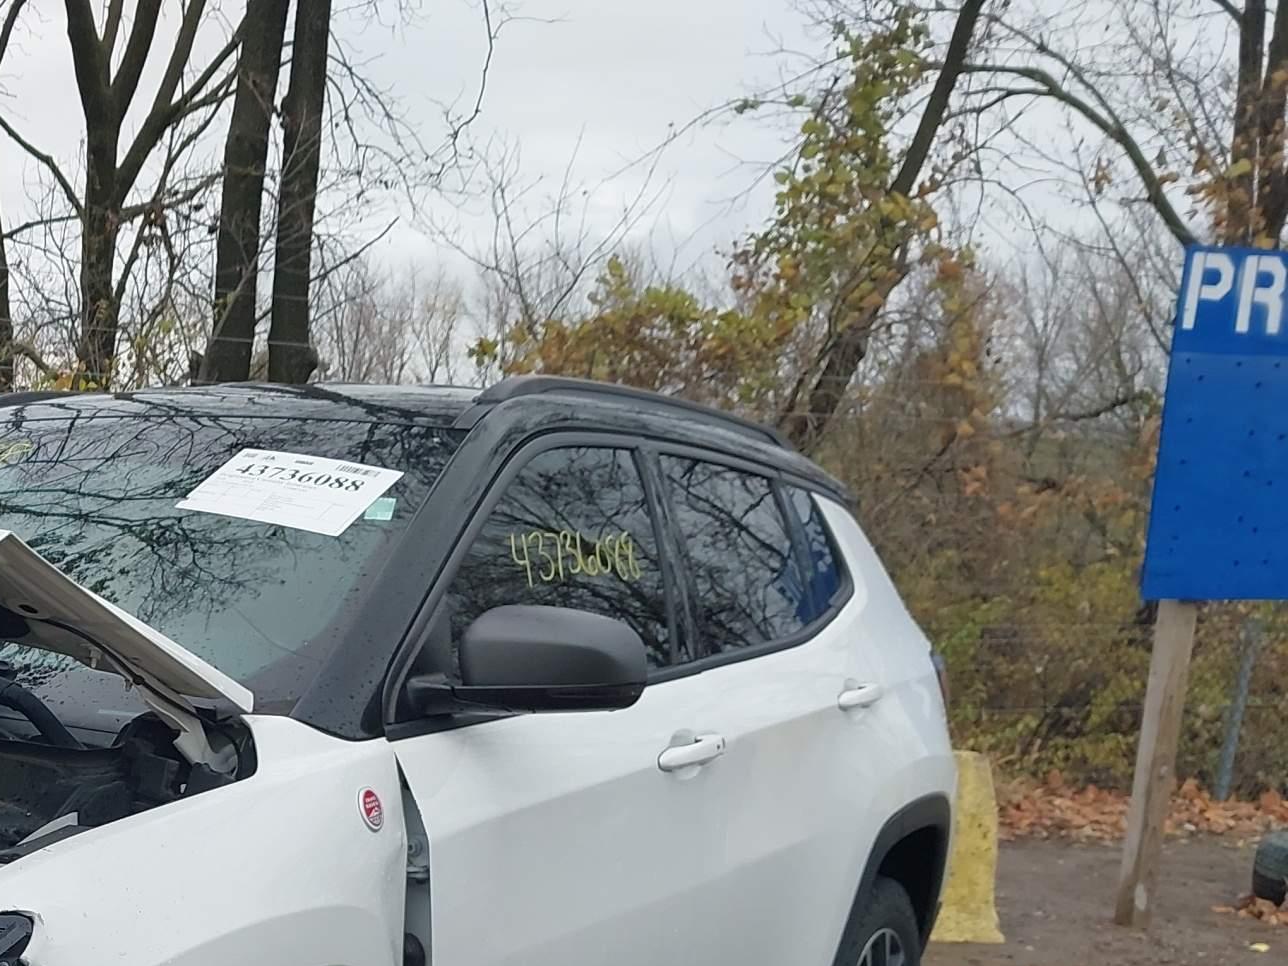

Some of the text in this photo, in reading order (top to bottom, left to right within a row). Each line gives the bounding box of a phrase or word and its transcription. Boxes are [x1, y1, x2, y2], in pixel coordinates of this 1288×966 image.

[1182, 251, 1287, 334] PR
[236, 463, 365, 492] 43736088
[510, 530, 640, 588] 43736088
